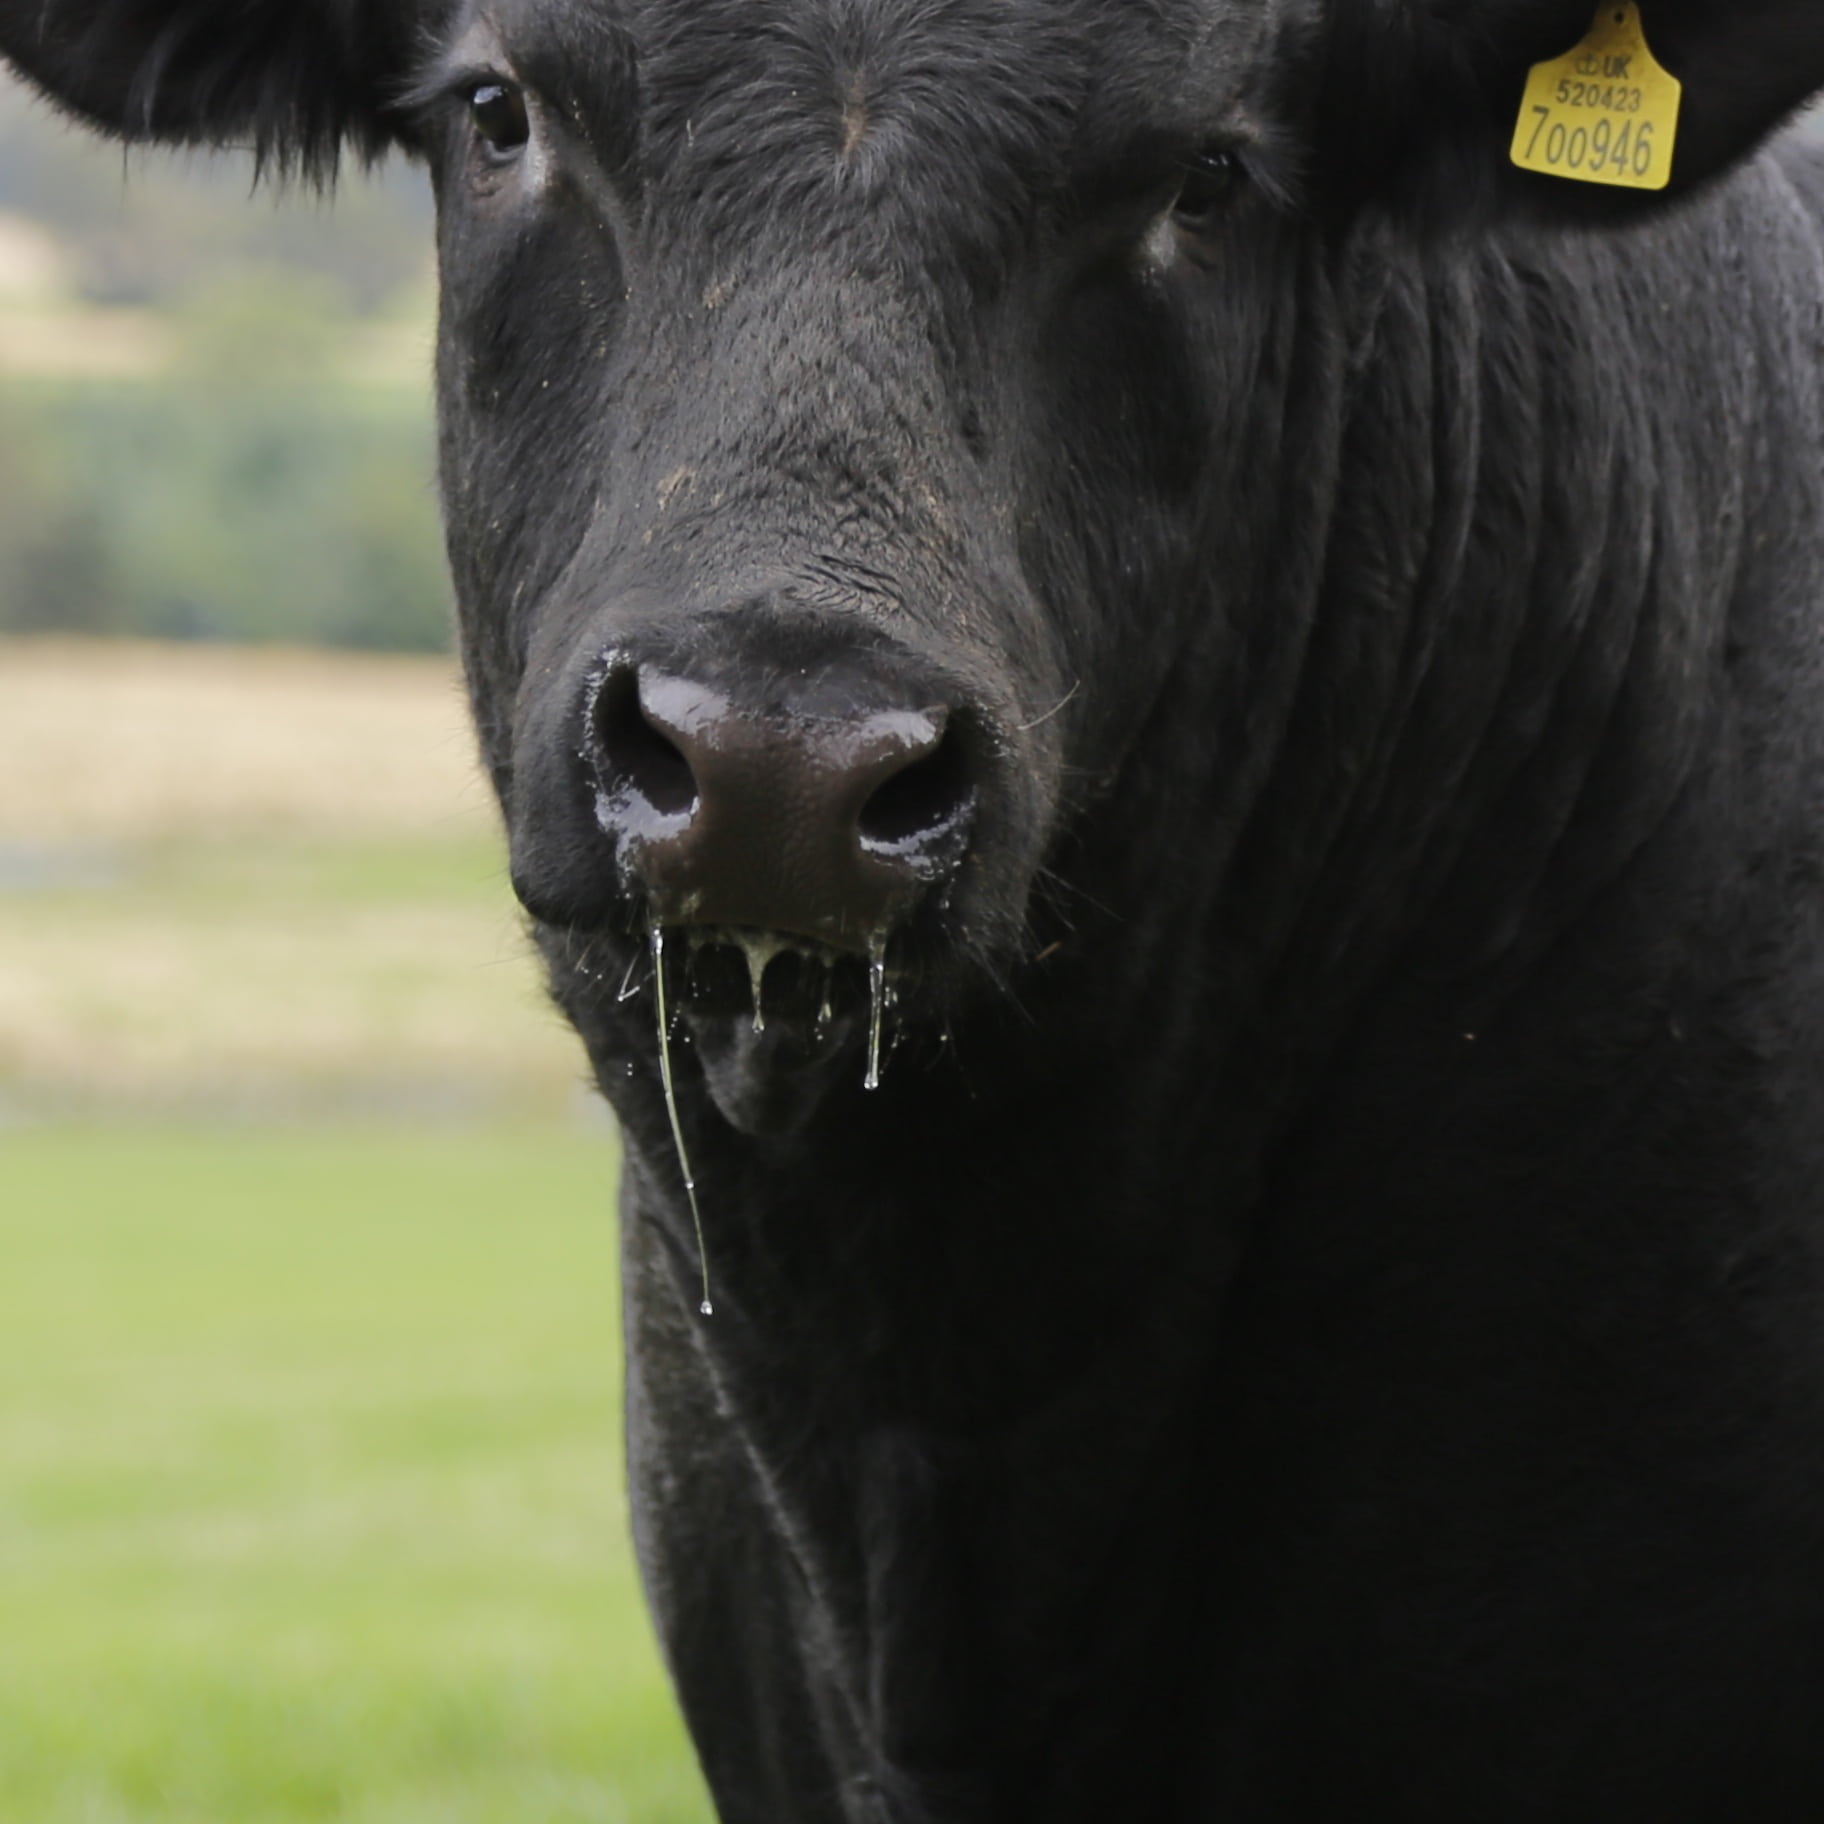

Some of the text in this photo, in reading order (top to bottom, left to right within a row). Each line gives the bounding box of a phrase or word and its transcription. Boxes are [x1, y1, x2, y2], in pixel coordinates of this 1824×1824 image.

[1603, 56, 1632, 80] UK
[1556, 79, 1642, 113] 520423
[1524, 105, 1654, 176] 700946
